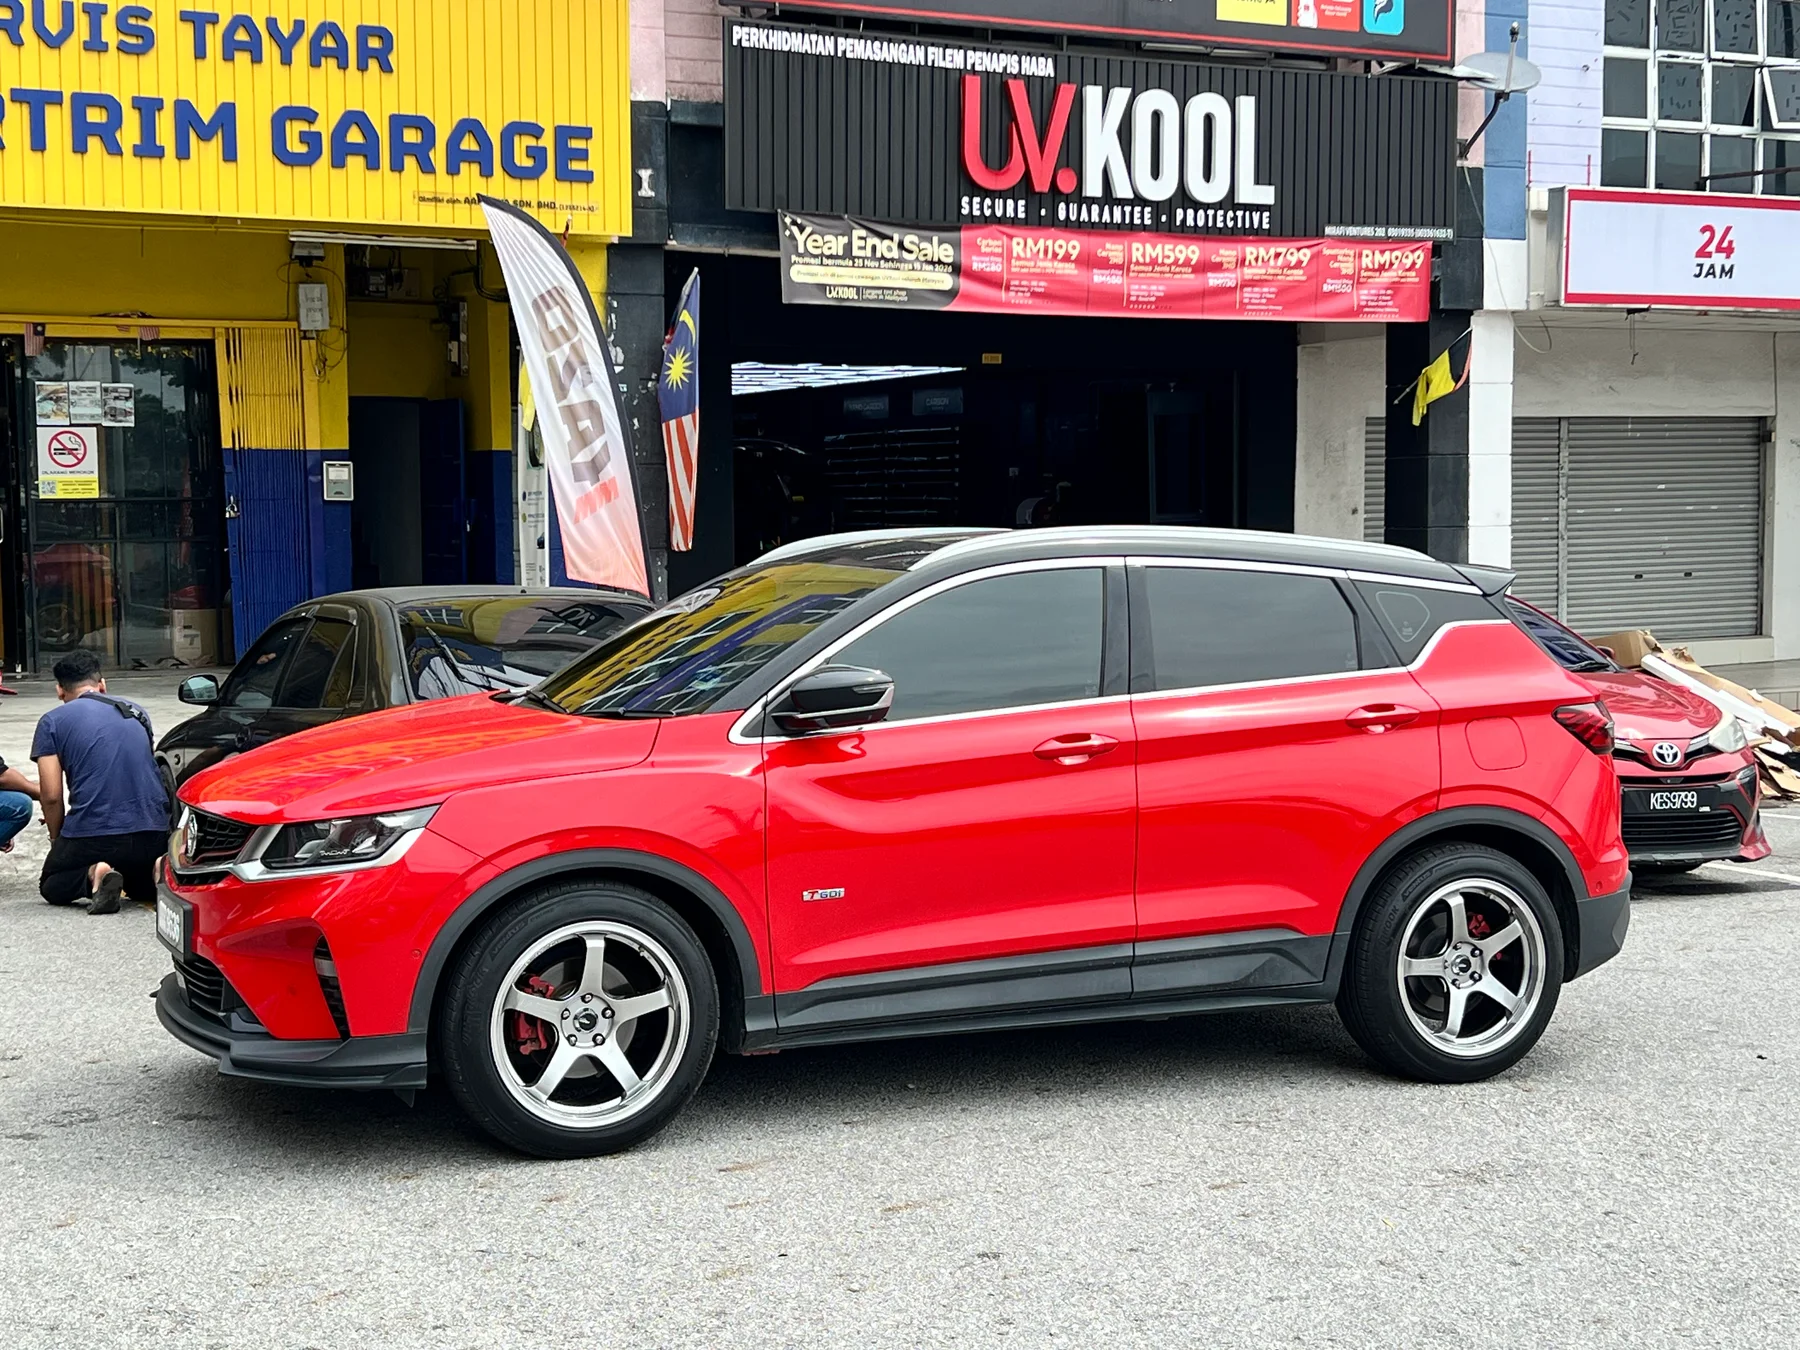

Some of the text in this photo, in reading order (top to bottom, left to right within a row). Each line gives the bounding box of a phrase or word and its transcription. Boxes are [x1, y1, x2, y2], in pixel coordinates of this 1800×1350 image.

[180, 10, 395, 74] TAYAR
[732, 25, 1055, 78] PERKHIDMATAN PEMASANGAN FILEM PENAPIS HABA
[0, 88, 595, 183] TRIM GARAGE
[961, 195, 1271, 230] SECURE GUARANTEE PROTECTIVE
[790, 225, 955, 264] Year End Sale
[1011, 236, 1081, 261] RM199
[1131, 242, 1200, 265] RM599
[1244, 246, 1311, 267] RM799
[1694, 224, 1736, 259] 24
[1360, 249, 1424, 270] RM999
[1693, 263, 1735, 279] JAM
[1650, 791, 1698, 810] KES9799
